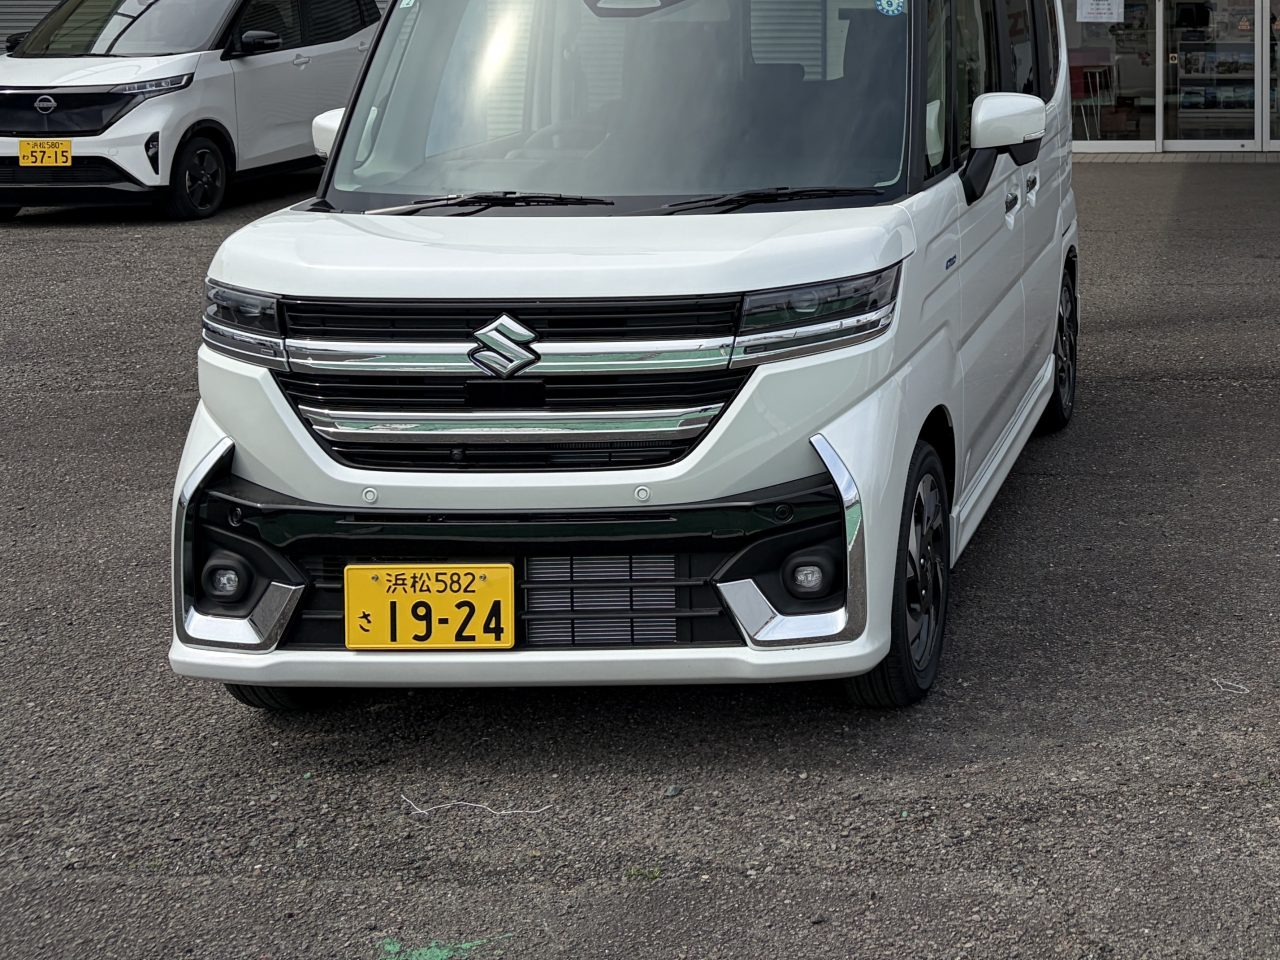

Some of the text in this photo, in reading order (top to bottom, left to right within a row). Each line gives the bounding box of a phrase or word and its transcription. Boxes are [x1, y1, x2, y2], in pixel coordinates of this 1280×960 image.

[30, 150, 69, 164] 57-15
[385, 572, 476, 594] 浜松582
[357, 599, 505, 642] さ 19-24
